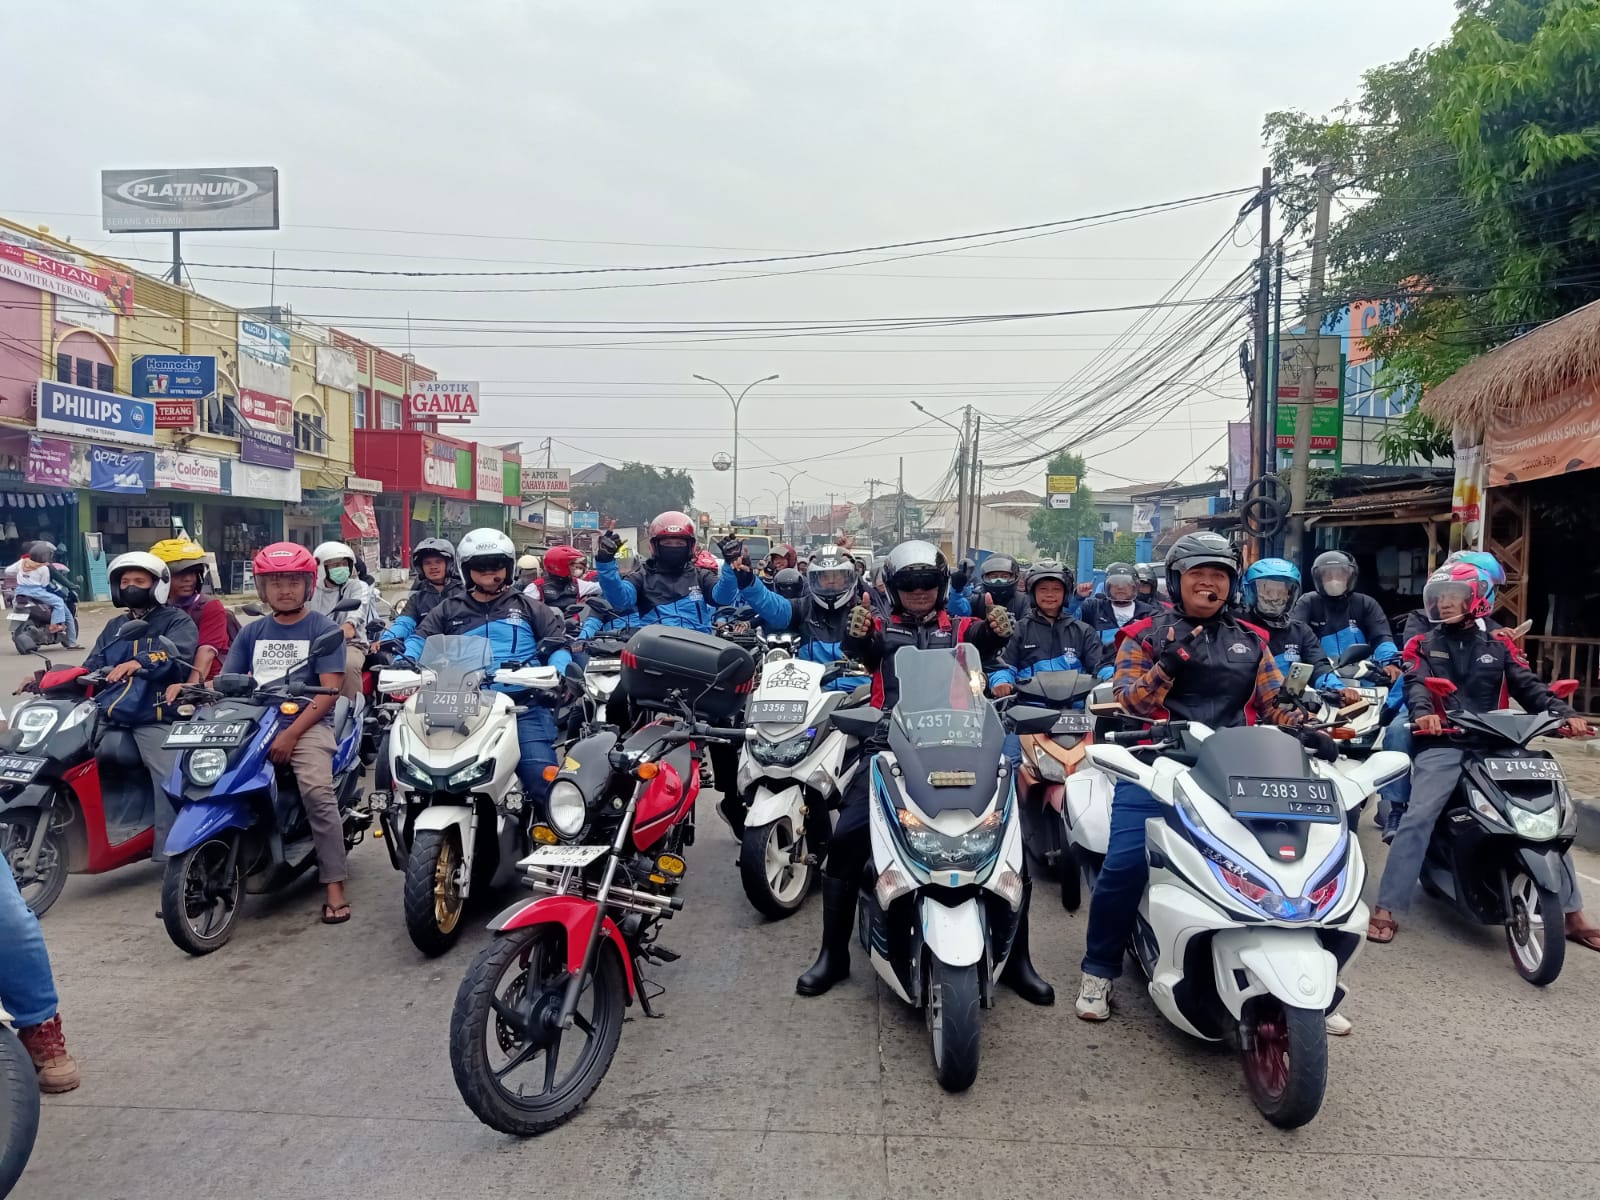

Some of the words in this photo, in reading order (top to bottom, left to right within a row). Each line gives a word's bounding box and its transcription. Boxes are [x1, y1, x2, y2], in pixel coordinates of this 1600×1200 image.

[134, 182, 240, 197] PLATINUM
[38, 257, 98, 285] KITANI
[24, 272, 54, 290] MITRA
[56, 282, 90, 301] TERANG
[146, 358, 200, 370] Hannochs
[426, 384, 469, 392] APOTIK
[52, 392, 122, 424] PHILIPS
[412, 393, 477, 412] GAMA
[159, 407, 192, 415] TERANG
[1537, 431, 1563, 445] MAKAN
[1563, 422, 1589, 439] SIANG
[93, 450, 128, 467] OPPLE
[1543, 455, 1556, 468] Jaya
[424, 457, 457, 489] GAMA
[521, 480, 546, 490] CAHAYA
[546, 480, 568, 490] FARMA
[418, 694, 424, 704] A
[433, 694, 457, 704] 2419
[792, 704, 803, 712] SK
[906, 719, 913, 730] A
[918, 714, 952, 728] 4357
[174, 726, 182, 735] A
[190, 725, 219, 734] 2024
[225, 725, 242, 734] CN
[1490, 761, 1498, 770] A
[1505, 761, 1537, 771] 2784
[1237, 782, 1245, 796] A
[1260, 783, 1298, 798] 2383
[1308, 785, 1327, 800] SU
